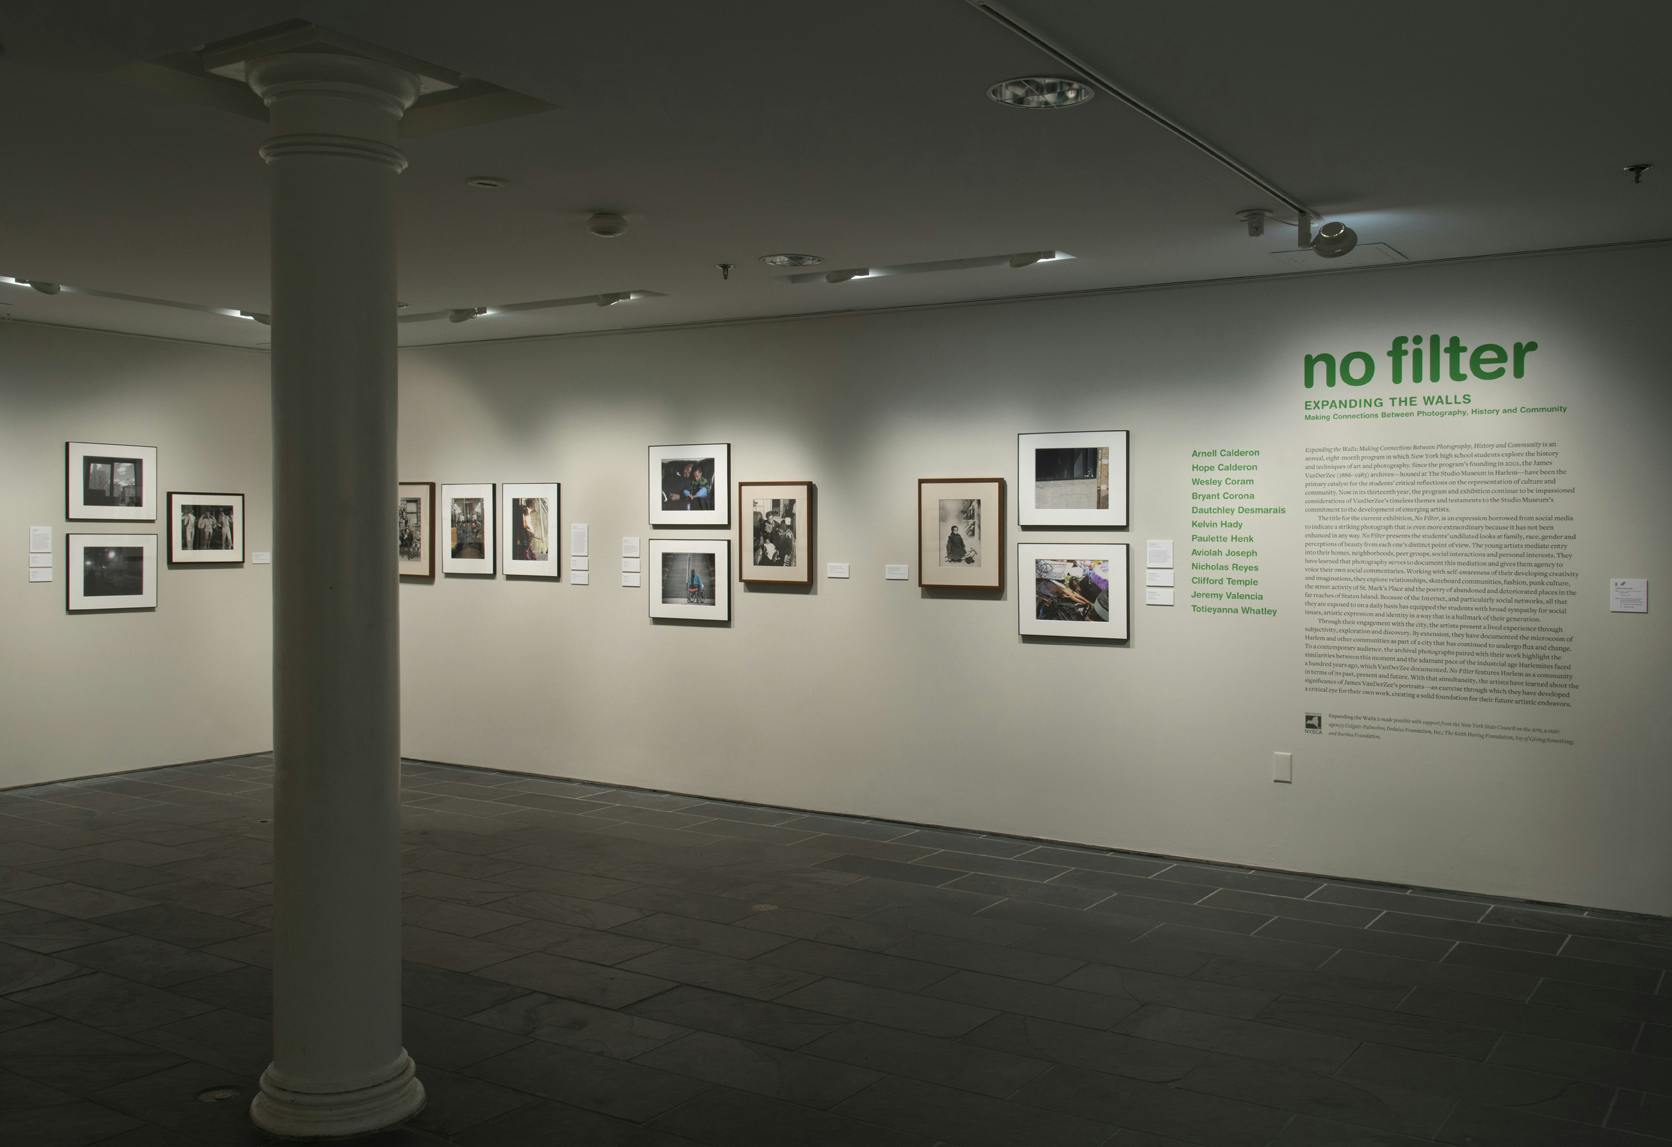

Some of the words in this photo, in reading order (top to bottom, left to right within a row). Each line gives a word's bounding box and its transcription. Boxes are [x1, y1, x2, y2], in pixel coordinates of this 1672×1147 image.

[1304, 351, 1375, 388] no
[1387, 334, 1538, 385] filter
[1304, 398, 1384, 410] EXPANDING
[1389, 396, 1418, 407] THE
[1422, 394, 1472, 406] WALLS
[1332, 412, 1379, 420] Connections
[1416, 408, 1469, 418] Photography,
[1471, 407, 1500, 415] History
[1502, 406, 1517, 414] and
[1519, 405, 1568, 413] Community
[1220, 448, 1260, 456] Calderon
[1192, 464, 1215, 472] Hope
[1192, 478, 1222, 486] Wesley
[1192, 492, 1220, 501] Bryant
[1192, 506, 1235, 515] Dautchley
[1220, 520, 1243, 529] Hady
[1225, 549, 1258, 558] Joseph
[1232, 563, 1258, 572] Reyes
[1192, 576, 1224, 584] Clifford
[1226, 578, 1258, 587] Temple
[1191, 591, 1224, 600] Jeremy
[1226, 592, 1264, 600] Valencia
[1240, 606, 1278, 616] Whatley
